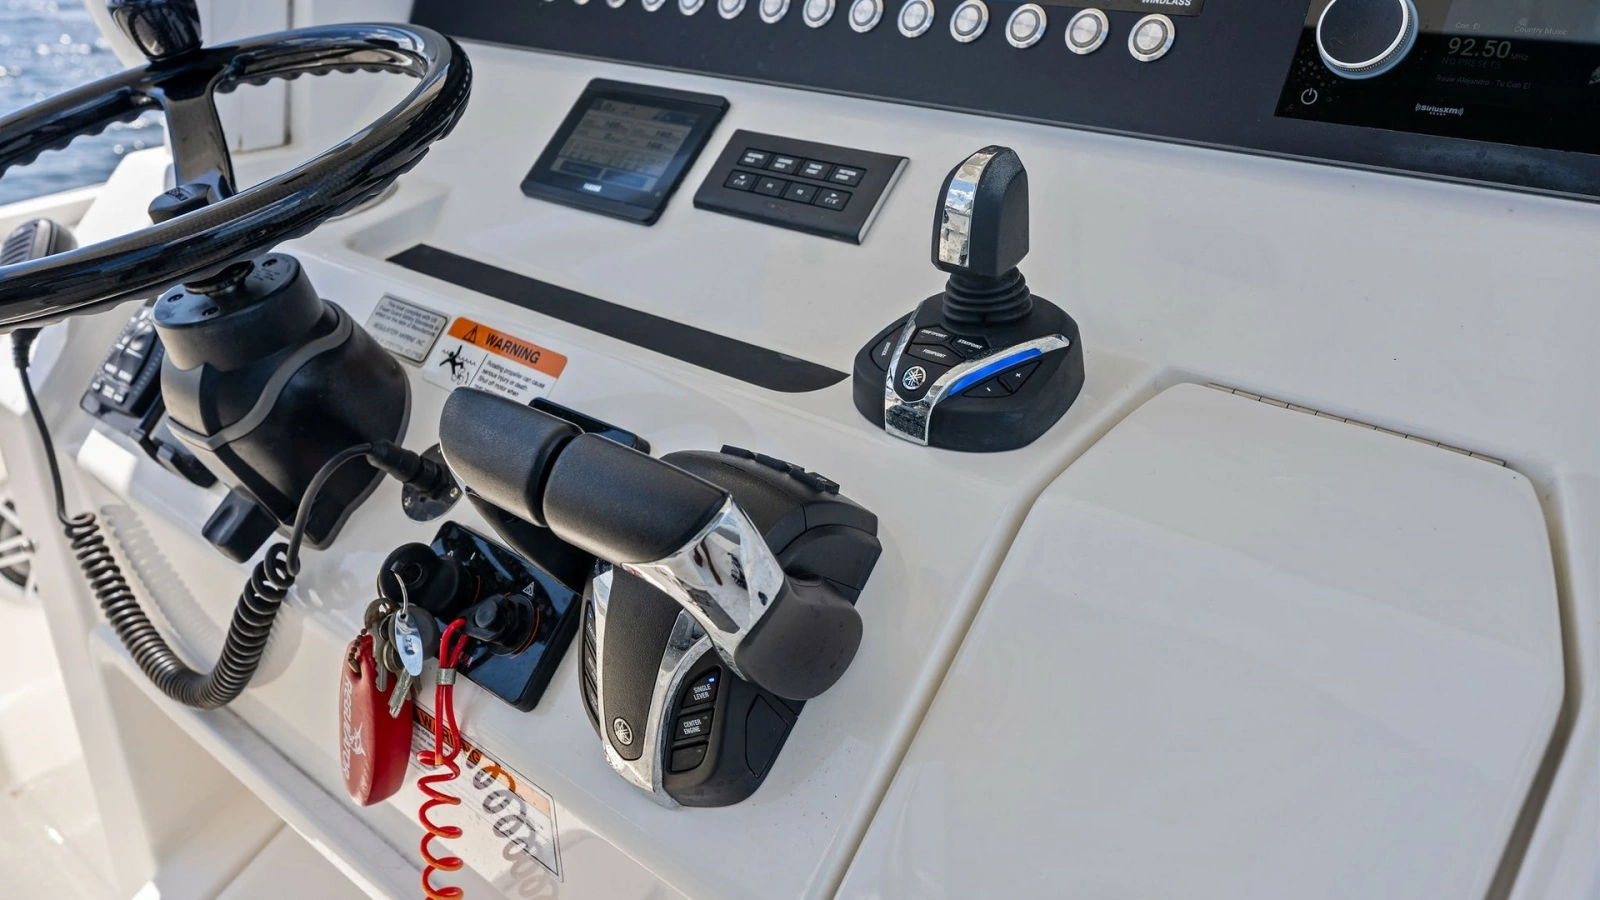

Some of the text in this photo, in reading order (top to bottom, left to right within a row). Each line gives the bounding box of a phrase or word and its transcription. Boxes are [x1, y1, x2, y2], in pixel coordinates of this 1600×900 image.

[1514, 25, 1568, 36] Country Music
[1448, 37, 1512, 59] 92.50
[1441, 57, 1502, 69] NO PRESETS
[1456, 76, 1490, 87] Alejandro
[485, 333, 540, 364] WARNING
[482, 368, 498, 378] serious
[497, 374, 509, 384] injury
[503, 369, 523, 379] propeller
[531, 379, 546, 389] cause
[478, 375, 488, 384] Shut
[494, 383, 507, 392] motor
[507, 388, 519, 397] when
[693, 683, 711, 694] SINGLE
[693, 691, 710, 701] LEVER
[342, 675, 353, 781] REGULATOR
[683, 718, 702, 728] CENTER
[683, 725, 701, 735] ENGINE
